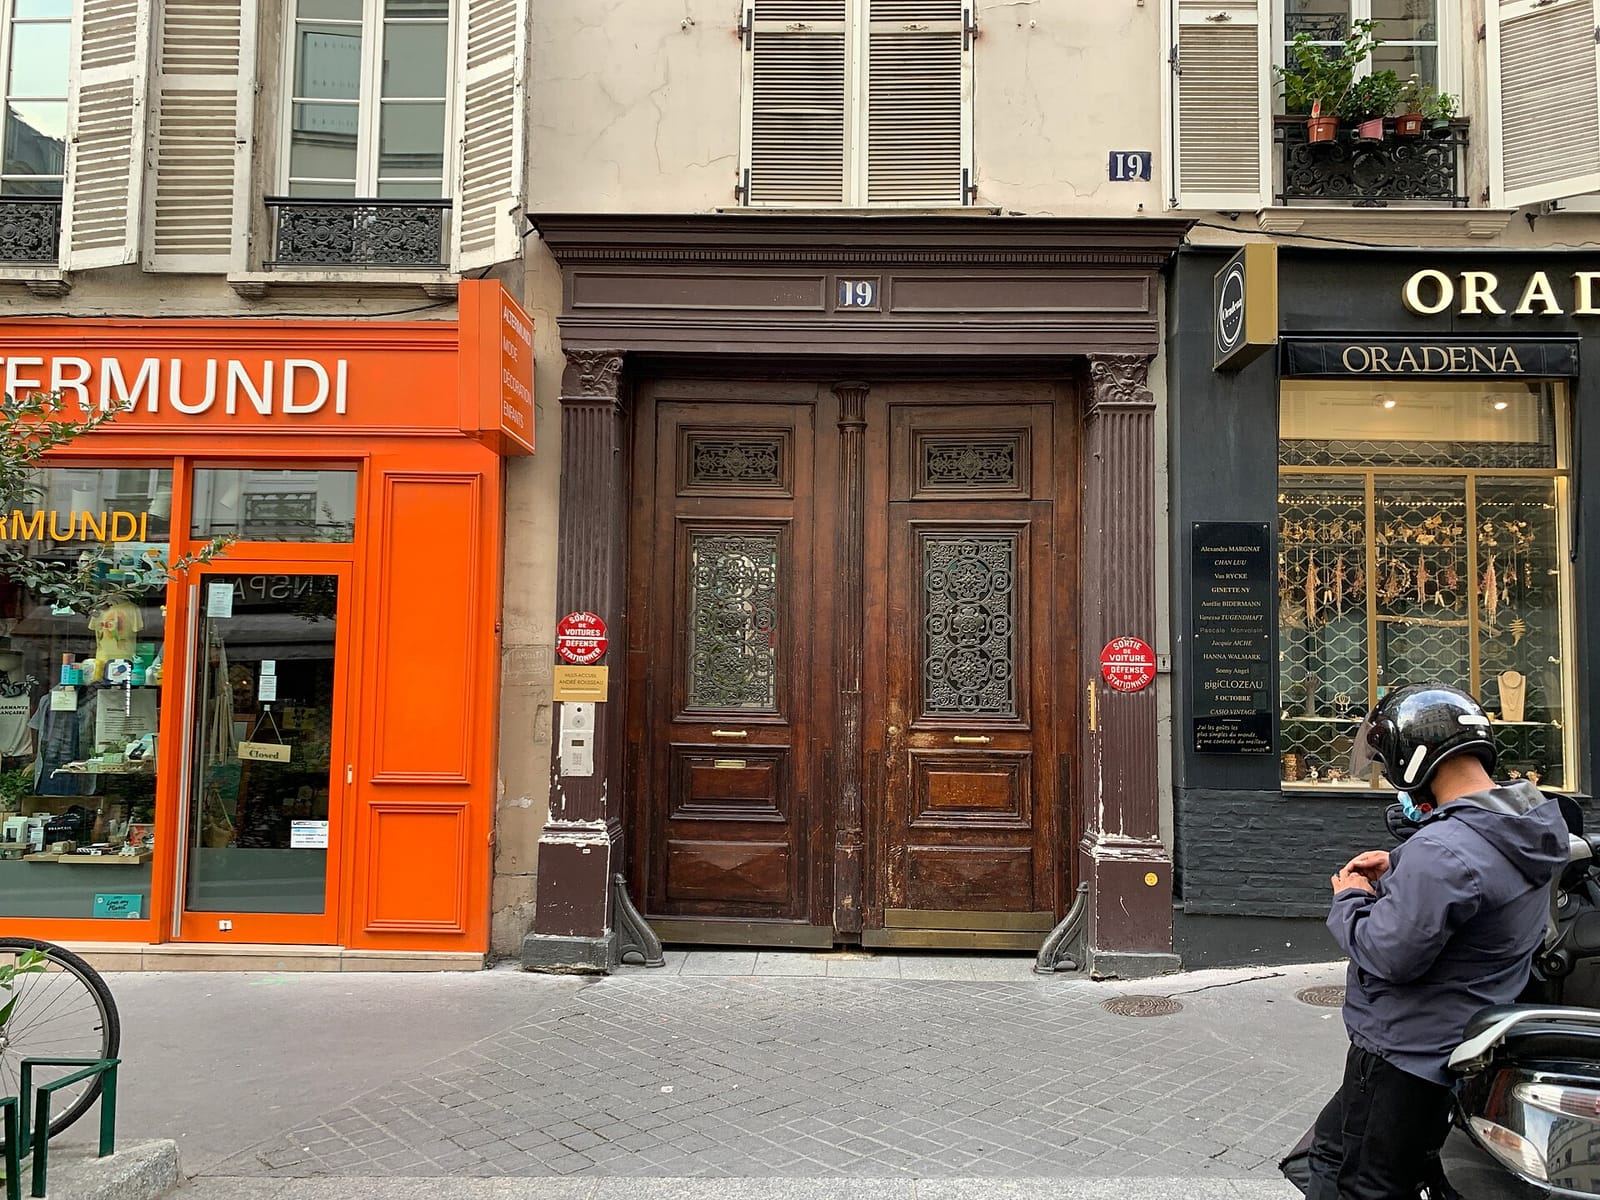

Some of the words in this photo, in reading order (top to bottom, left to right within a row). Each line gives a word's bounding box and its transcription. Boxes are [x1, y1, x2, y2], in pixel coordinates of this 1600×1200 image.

[1116, 154, 1142, 179] 19
[844, 281, 872, 307] 19
[503, 306, 532, 347] ALTERMUNDI
[503, 336, 518, 362] MODE
[1342, 345, 1525, 373] ORADENA
[0, 356, 348, 415] ERMUNDI
[503, 400, 524, 429] ENFANTS
[569, 614, 596, 624] SORTIE
[561, 648, 601, 662] STATIONNER
[1113, 640, 1142, 650] SORTIE
[1108, 674, 1149, 689] STATIONNER
[1204, 680, 1263, 690] gigiCLOZEAU
[249, 750, 279, 759] Closed
